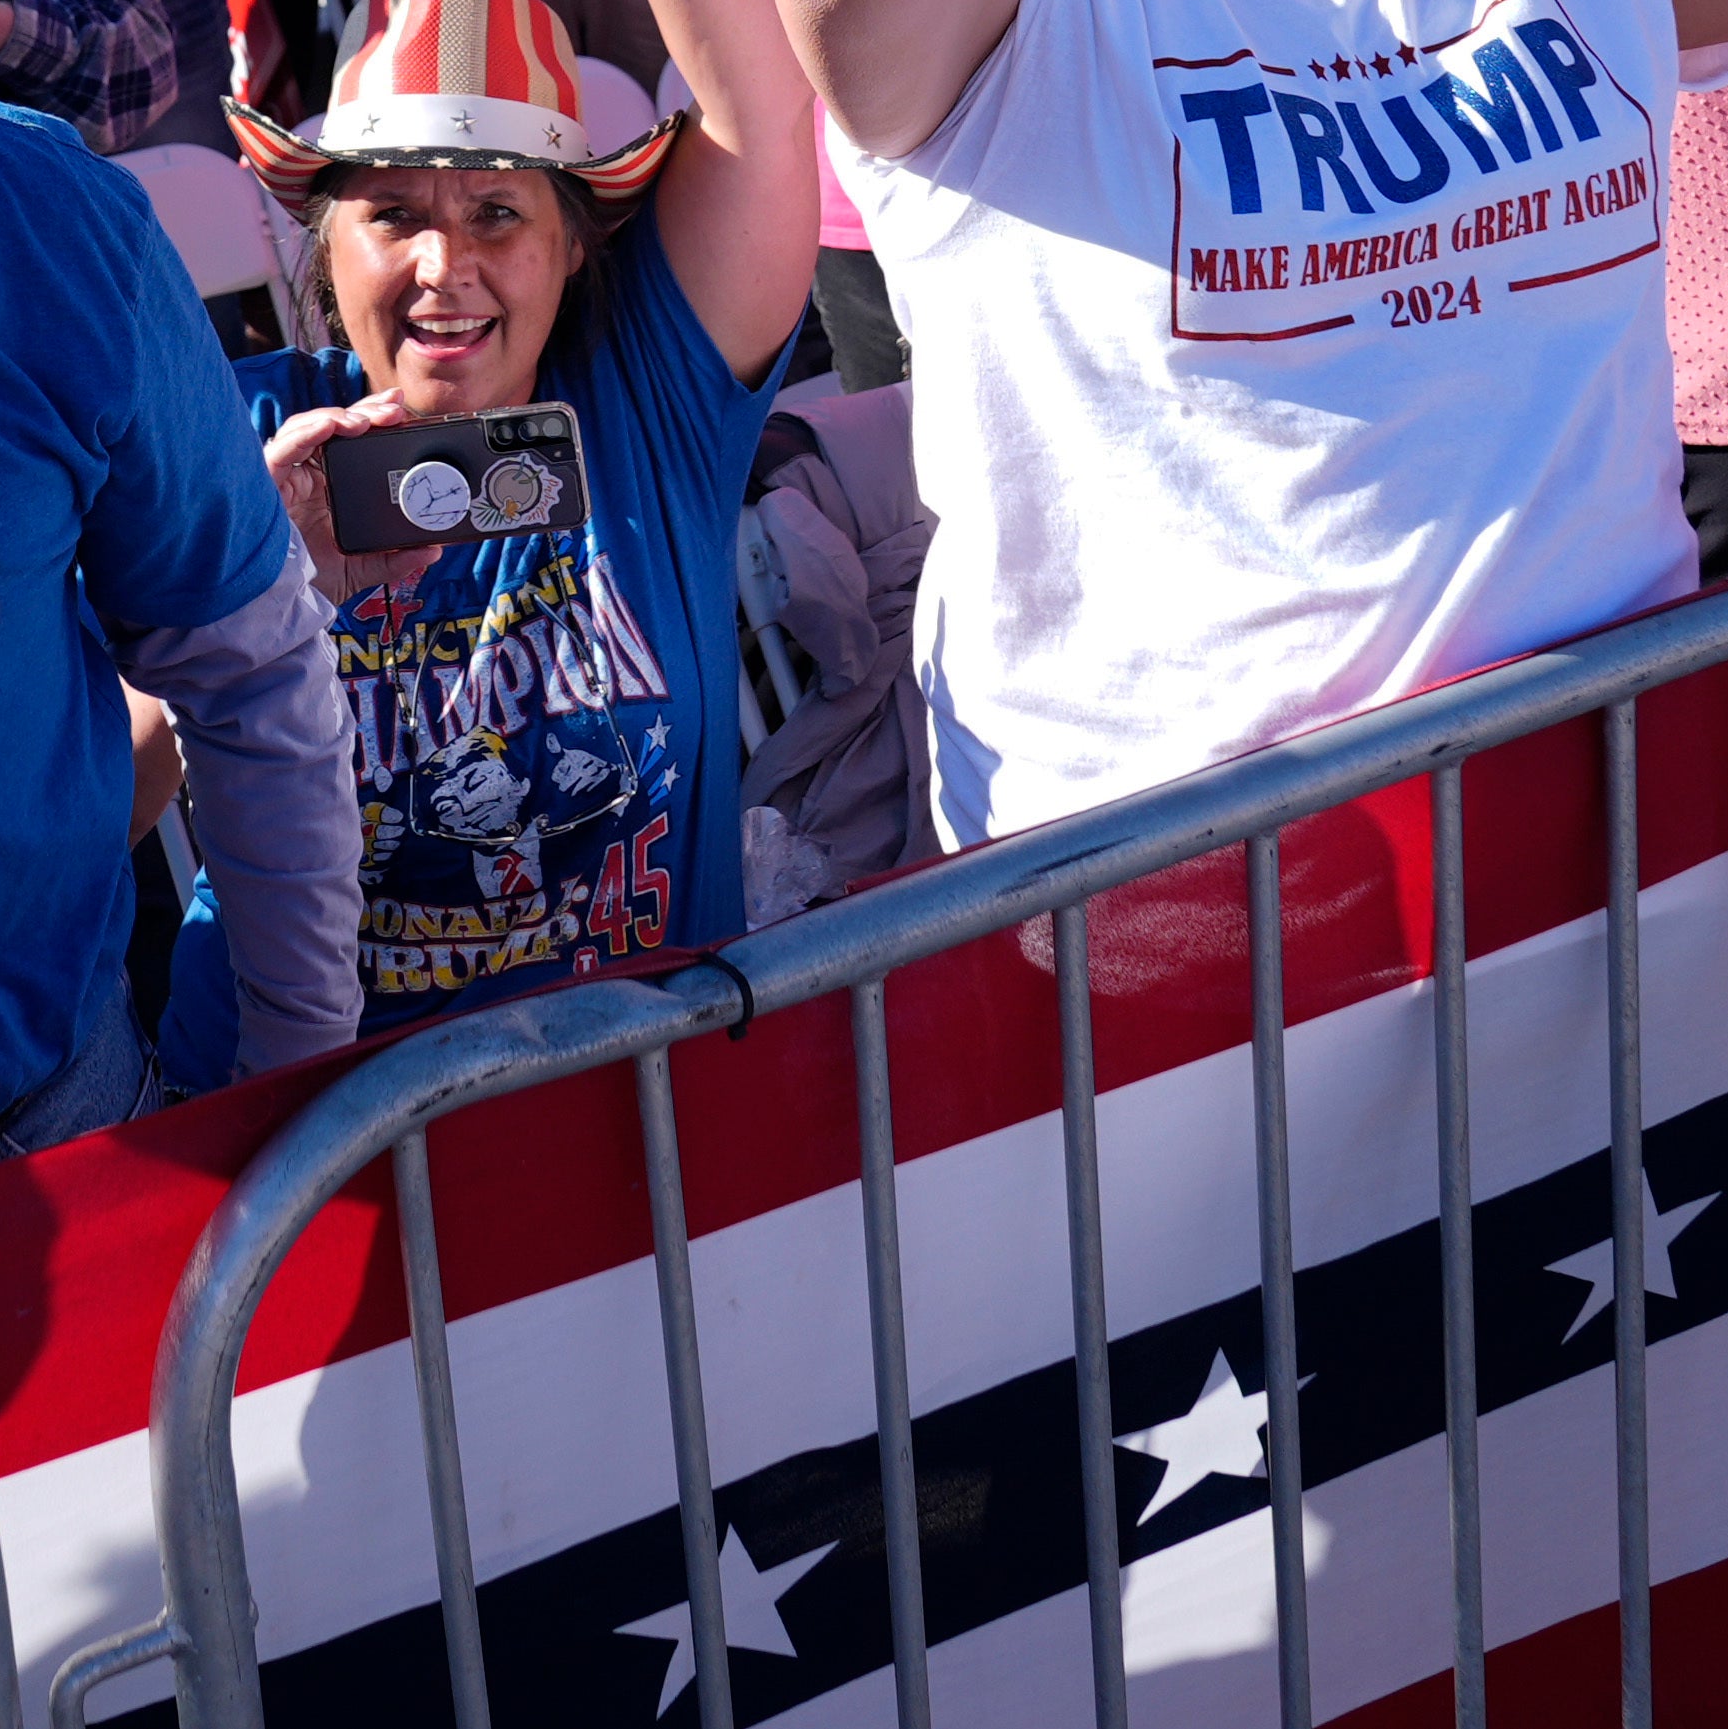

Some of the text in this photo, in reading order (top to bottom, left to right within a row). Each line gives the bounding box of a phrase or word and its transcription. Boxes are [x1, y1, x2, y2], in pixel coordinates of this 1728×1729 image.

[1180, 17, 1602, 216] TRUMP
[1189, 156, 1649, 294] MAKE AMERICA GREAT AGAIN
[1380, 275, 1482, 329] 2024
[587, 812, 671, 956] 45
